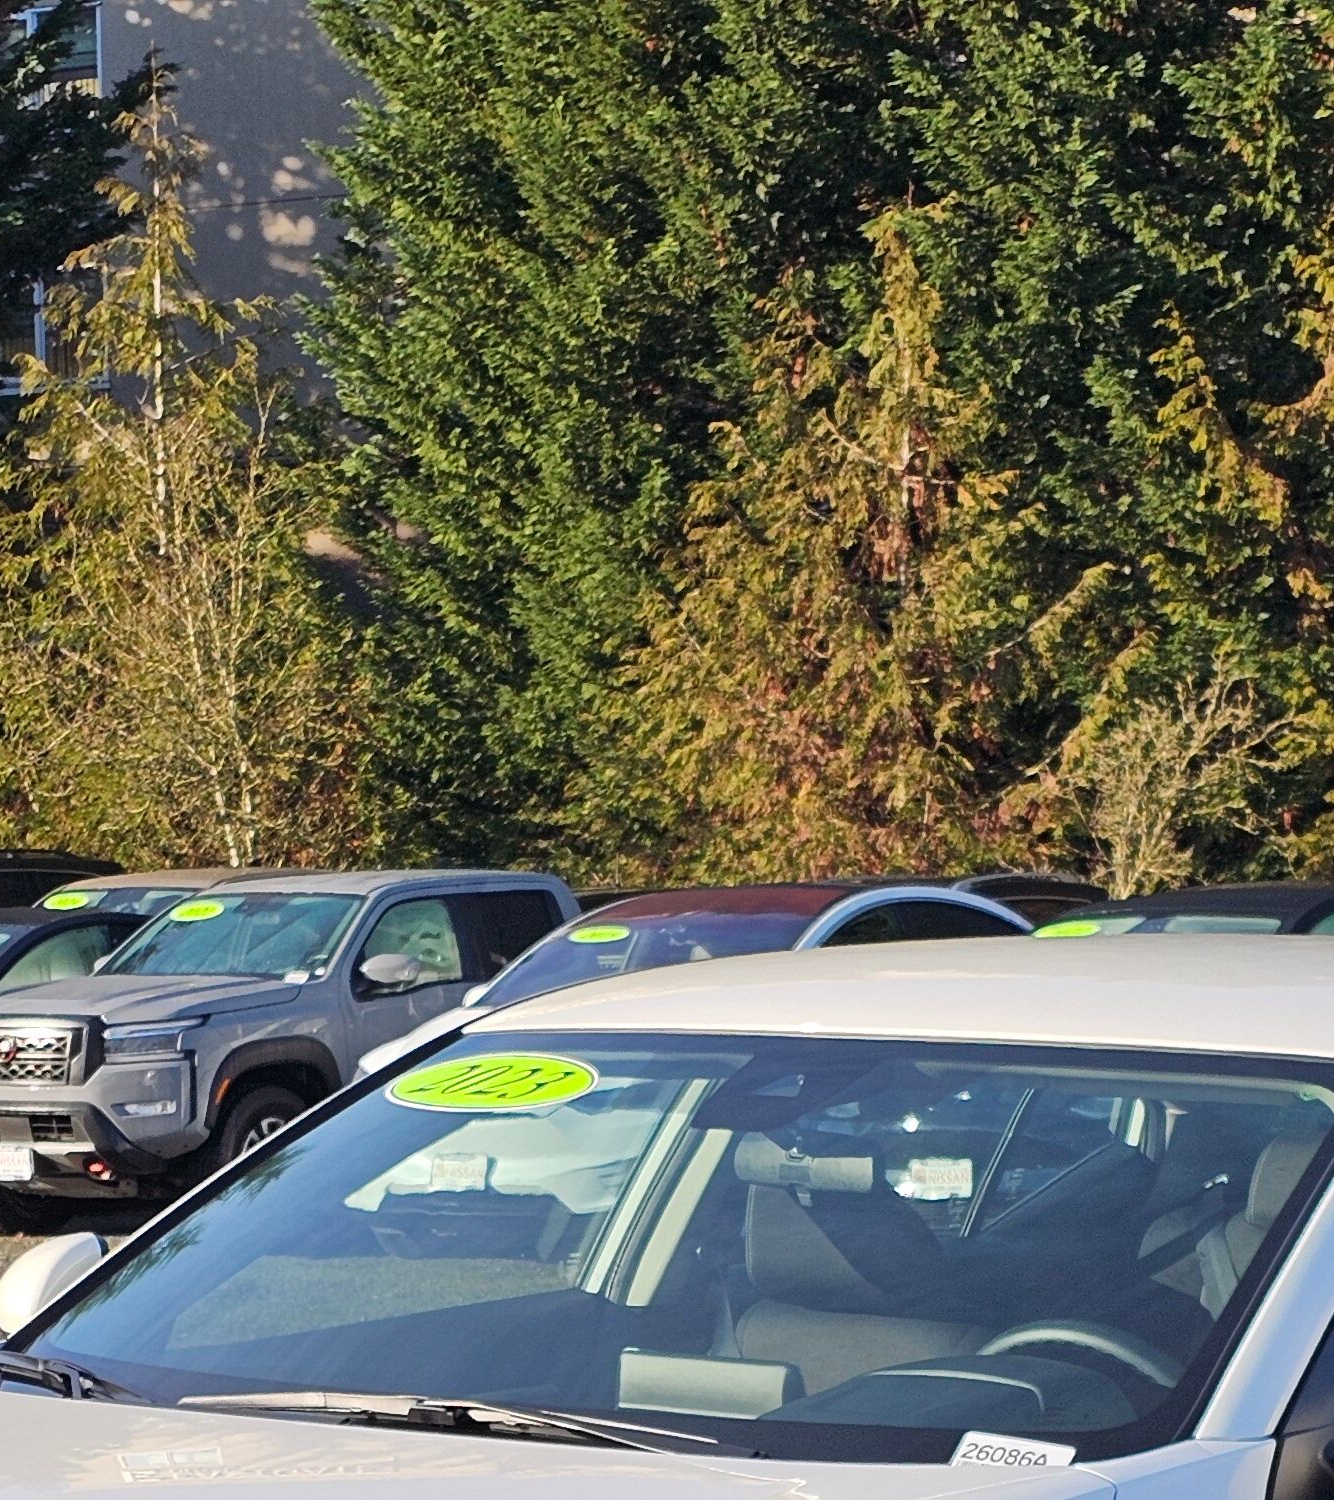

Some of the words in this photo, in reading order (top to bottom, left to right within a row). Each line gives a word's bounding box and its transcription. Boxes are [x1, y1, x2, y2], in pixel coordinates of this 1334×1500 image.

[407, 1063, 577, 1099] 2023
[929, 1173, 969, 1184] NISSAN
[960, 1442, 1048, 1466] 26086A
